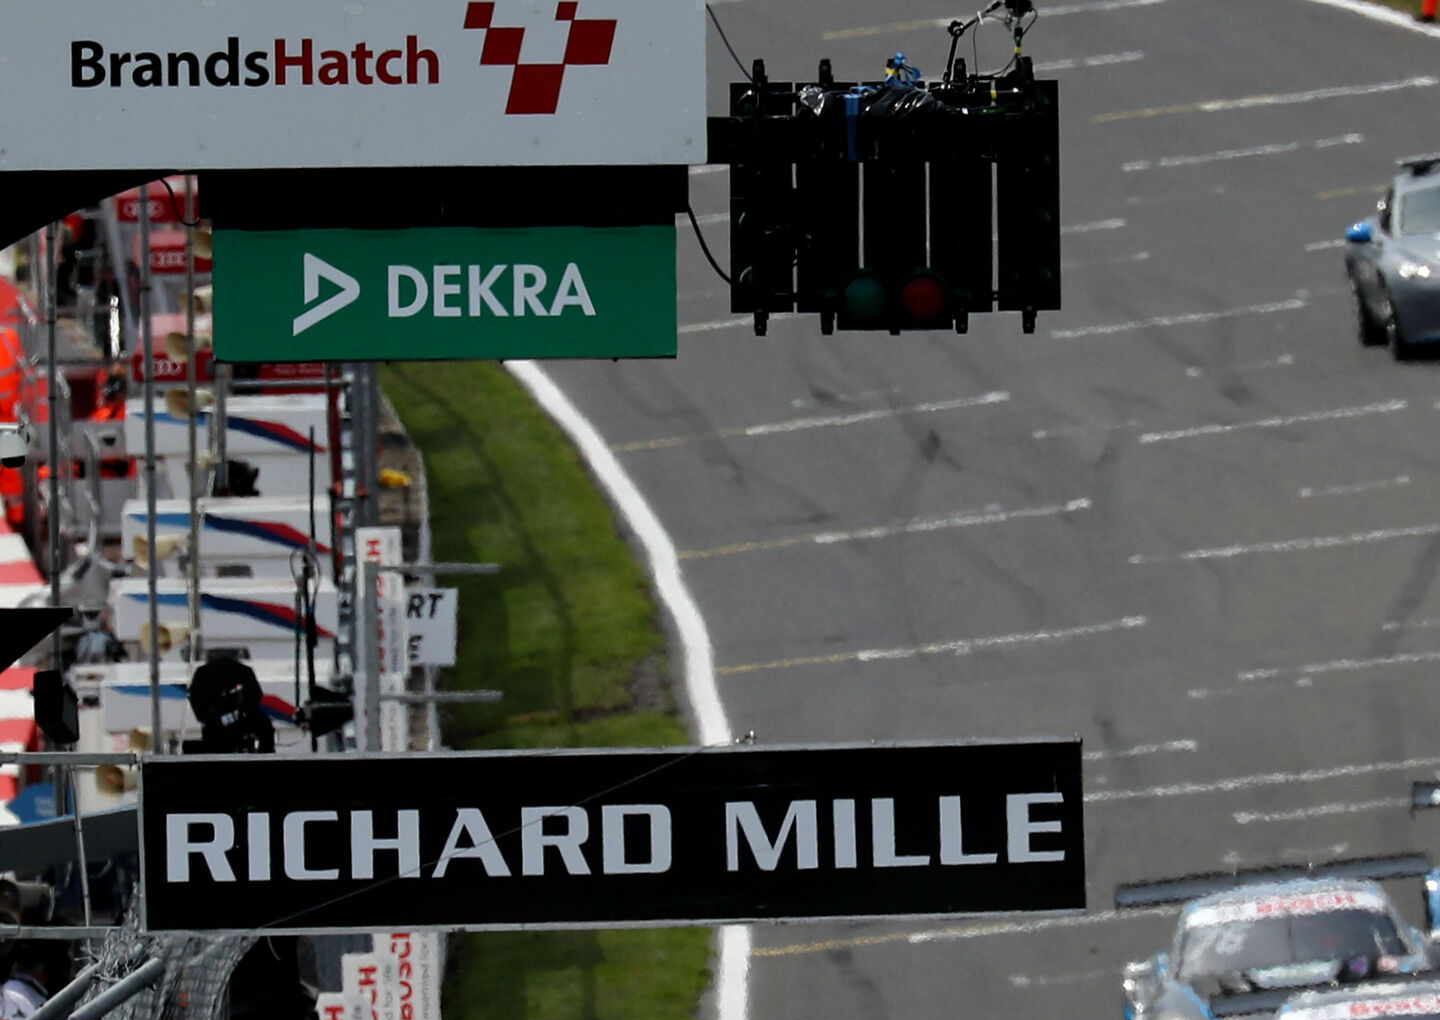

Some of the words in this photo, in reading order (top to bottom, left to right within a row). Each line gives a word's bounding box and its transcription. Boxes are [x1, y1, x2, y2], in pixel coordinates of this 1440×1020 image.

[71, 36, 440, 87] BrandsHatch
[388, 263, 597, 317] DEKRA
[166, 803, 672, 881] RICHARD
[725, 792, 1065, 872] MILLE
